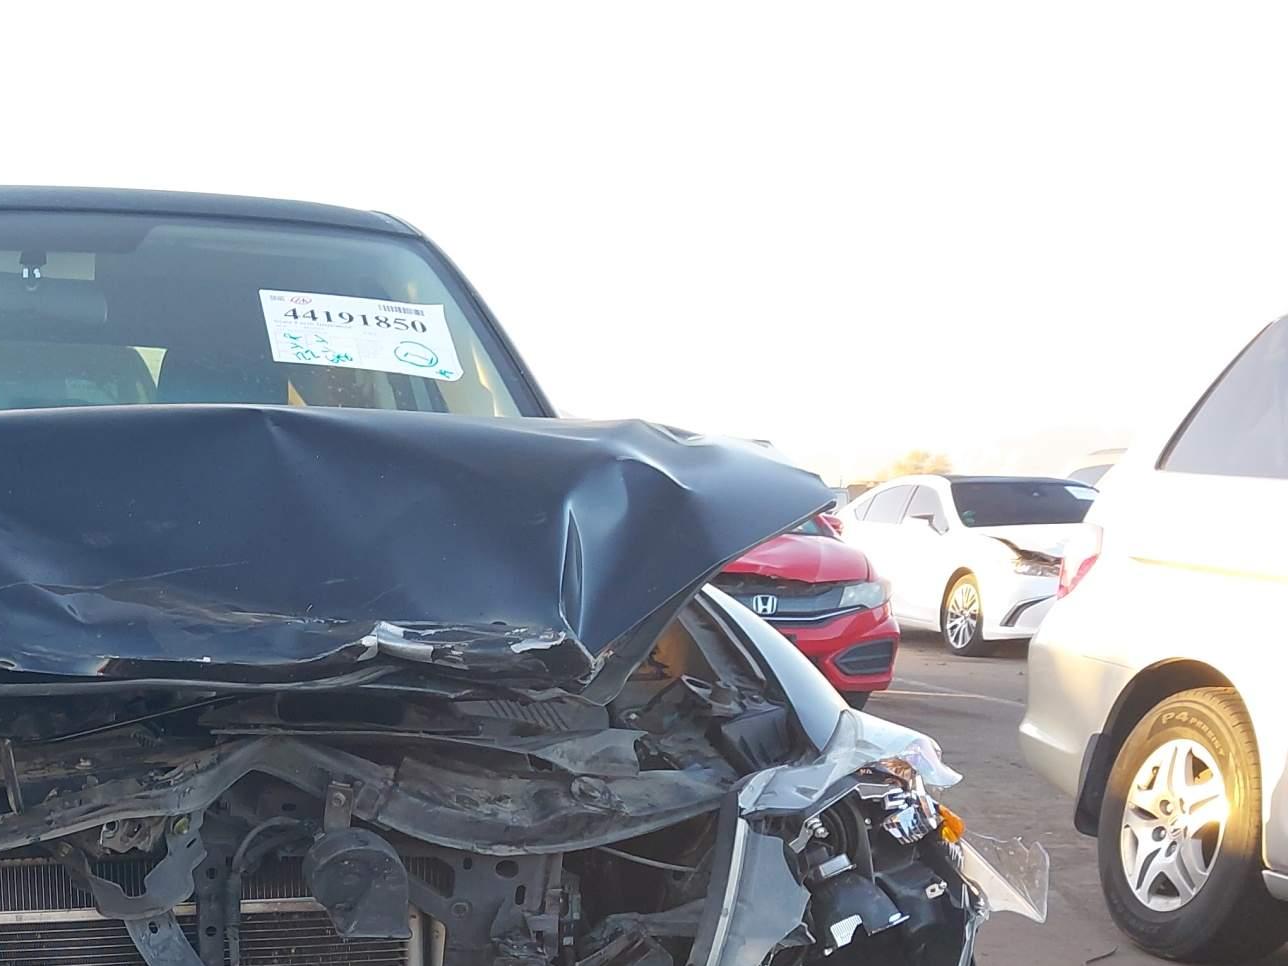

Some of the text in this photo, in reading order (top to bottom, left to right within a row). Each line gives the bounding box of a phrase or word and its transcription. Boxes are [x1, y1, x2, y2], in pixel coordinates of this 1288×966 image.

[283, 307, 428, 334] 44191850
[1161, 711, 1226, 757] P4 PERSIST
